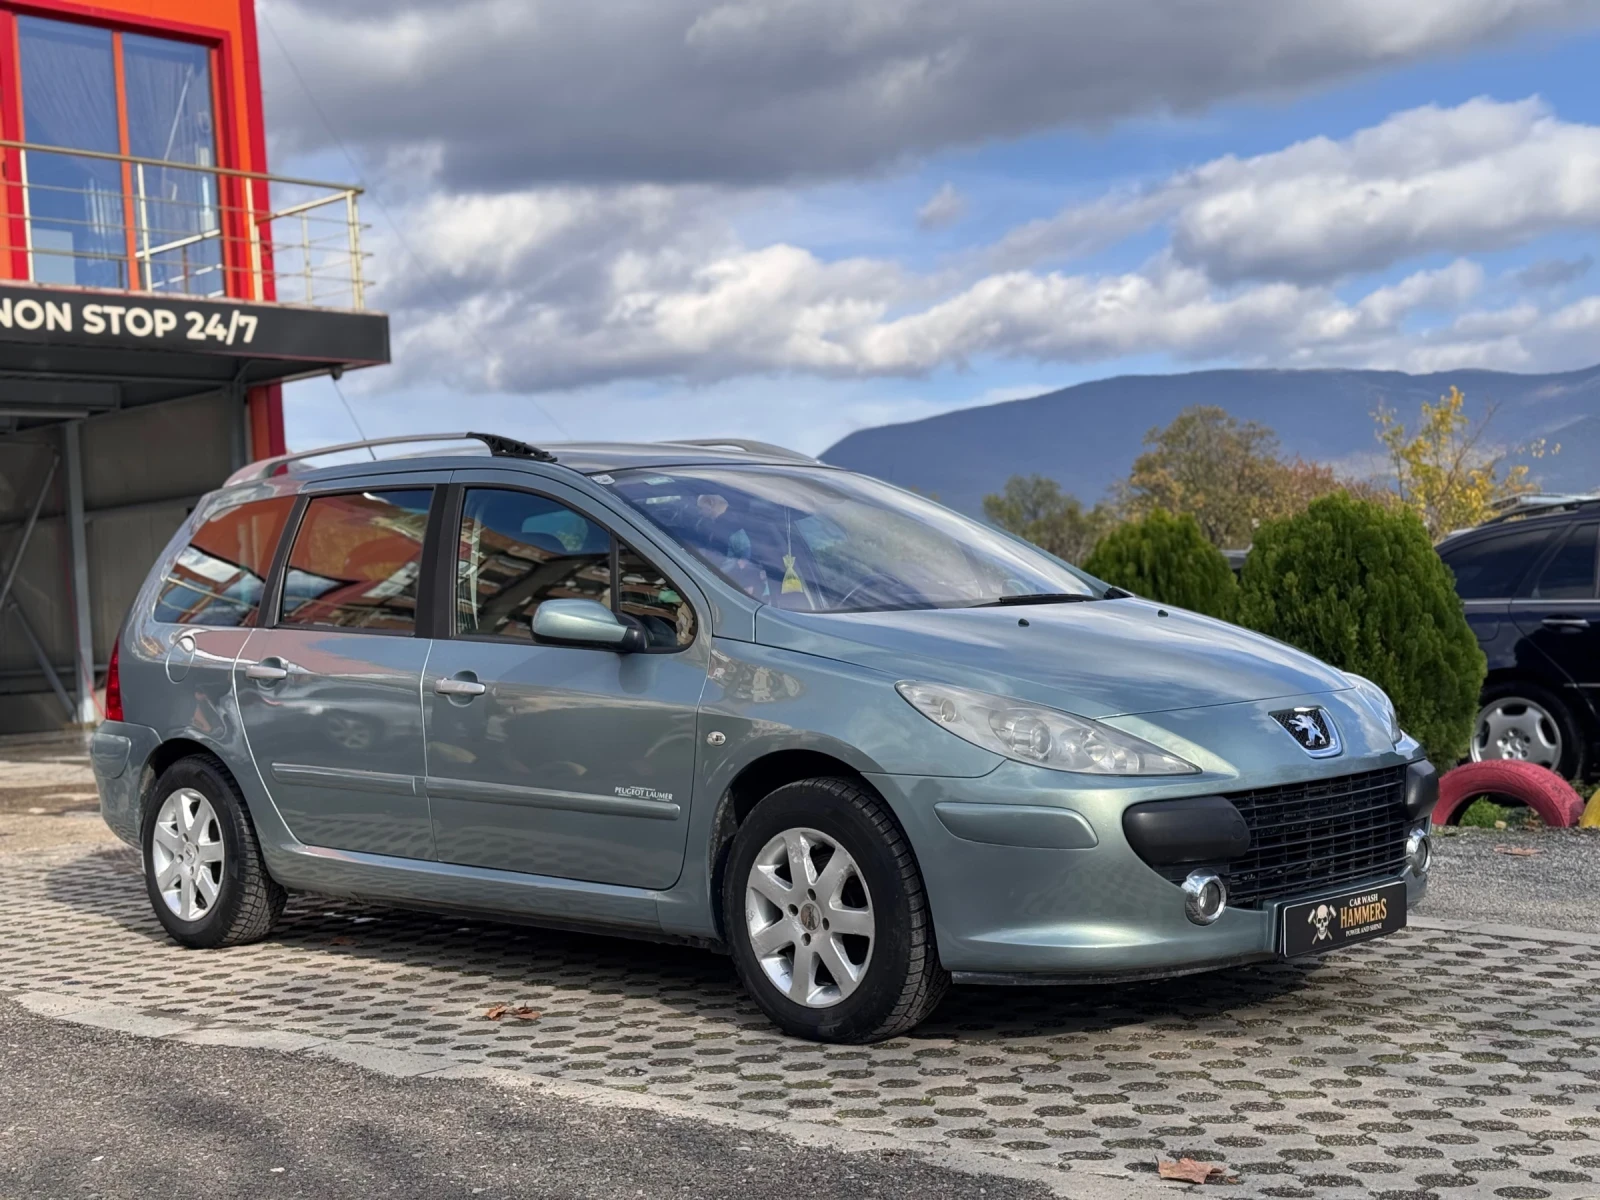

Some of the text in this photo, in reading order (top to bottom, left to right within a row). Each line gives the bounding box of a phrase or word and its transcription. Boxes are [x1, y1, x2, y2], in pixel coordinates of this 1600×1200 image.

[82, 304, 177, 337] STOP
[184, 310, 258, 345] 24/7
[614, 786, 644, 796] PEUGEOT
[1349, 893, 1378, 907] CAR WASH
[1340, 898, 1387, 929] HAMMERS
